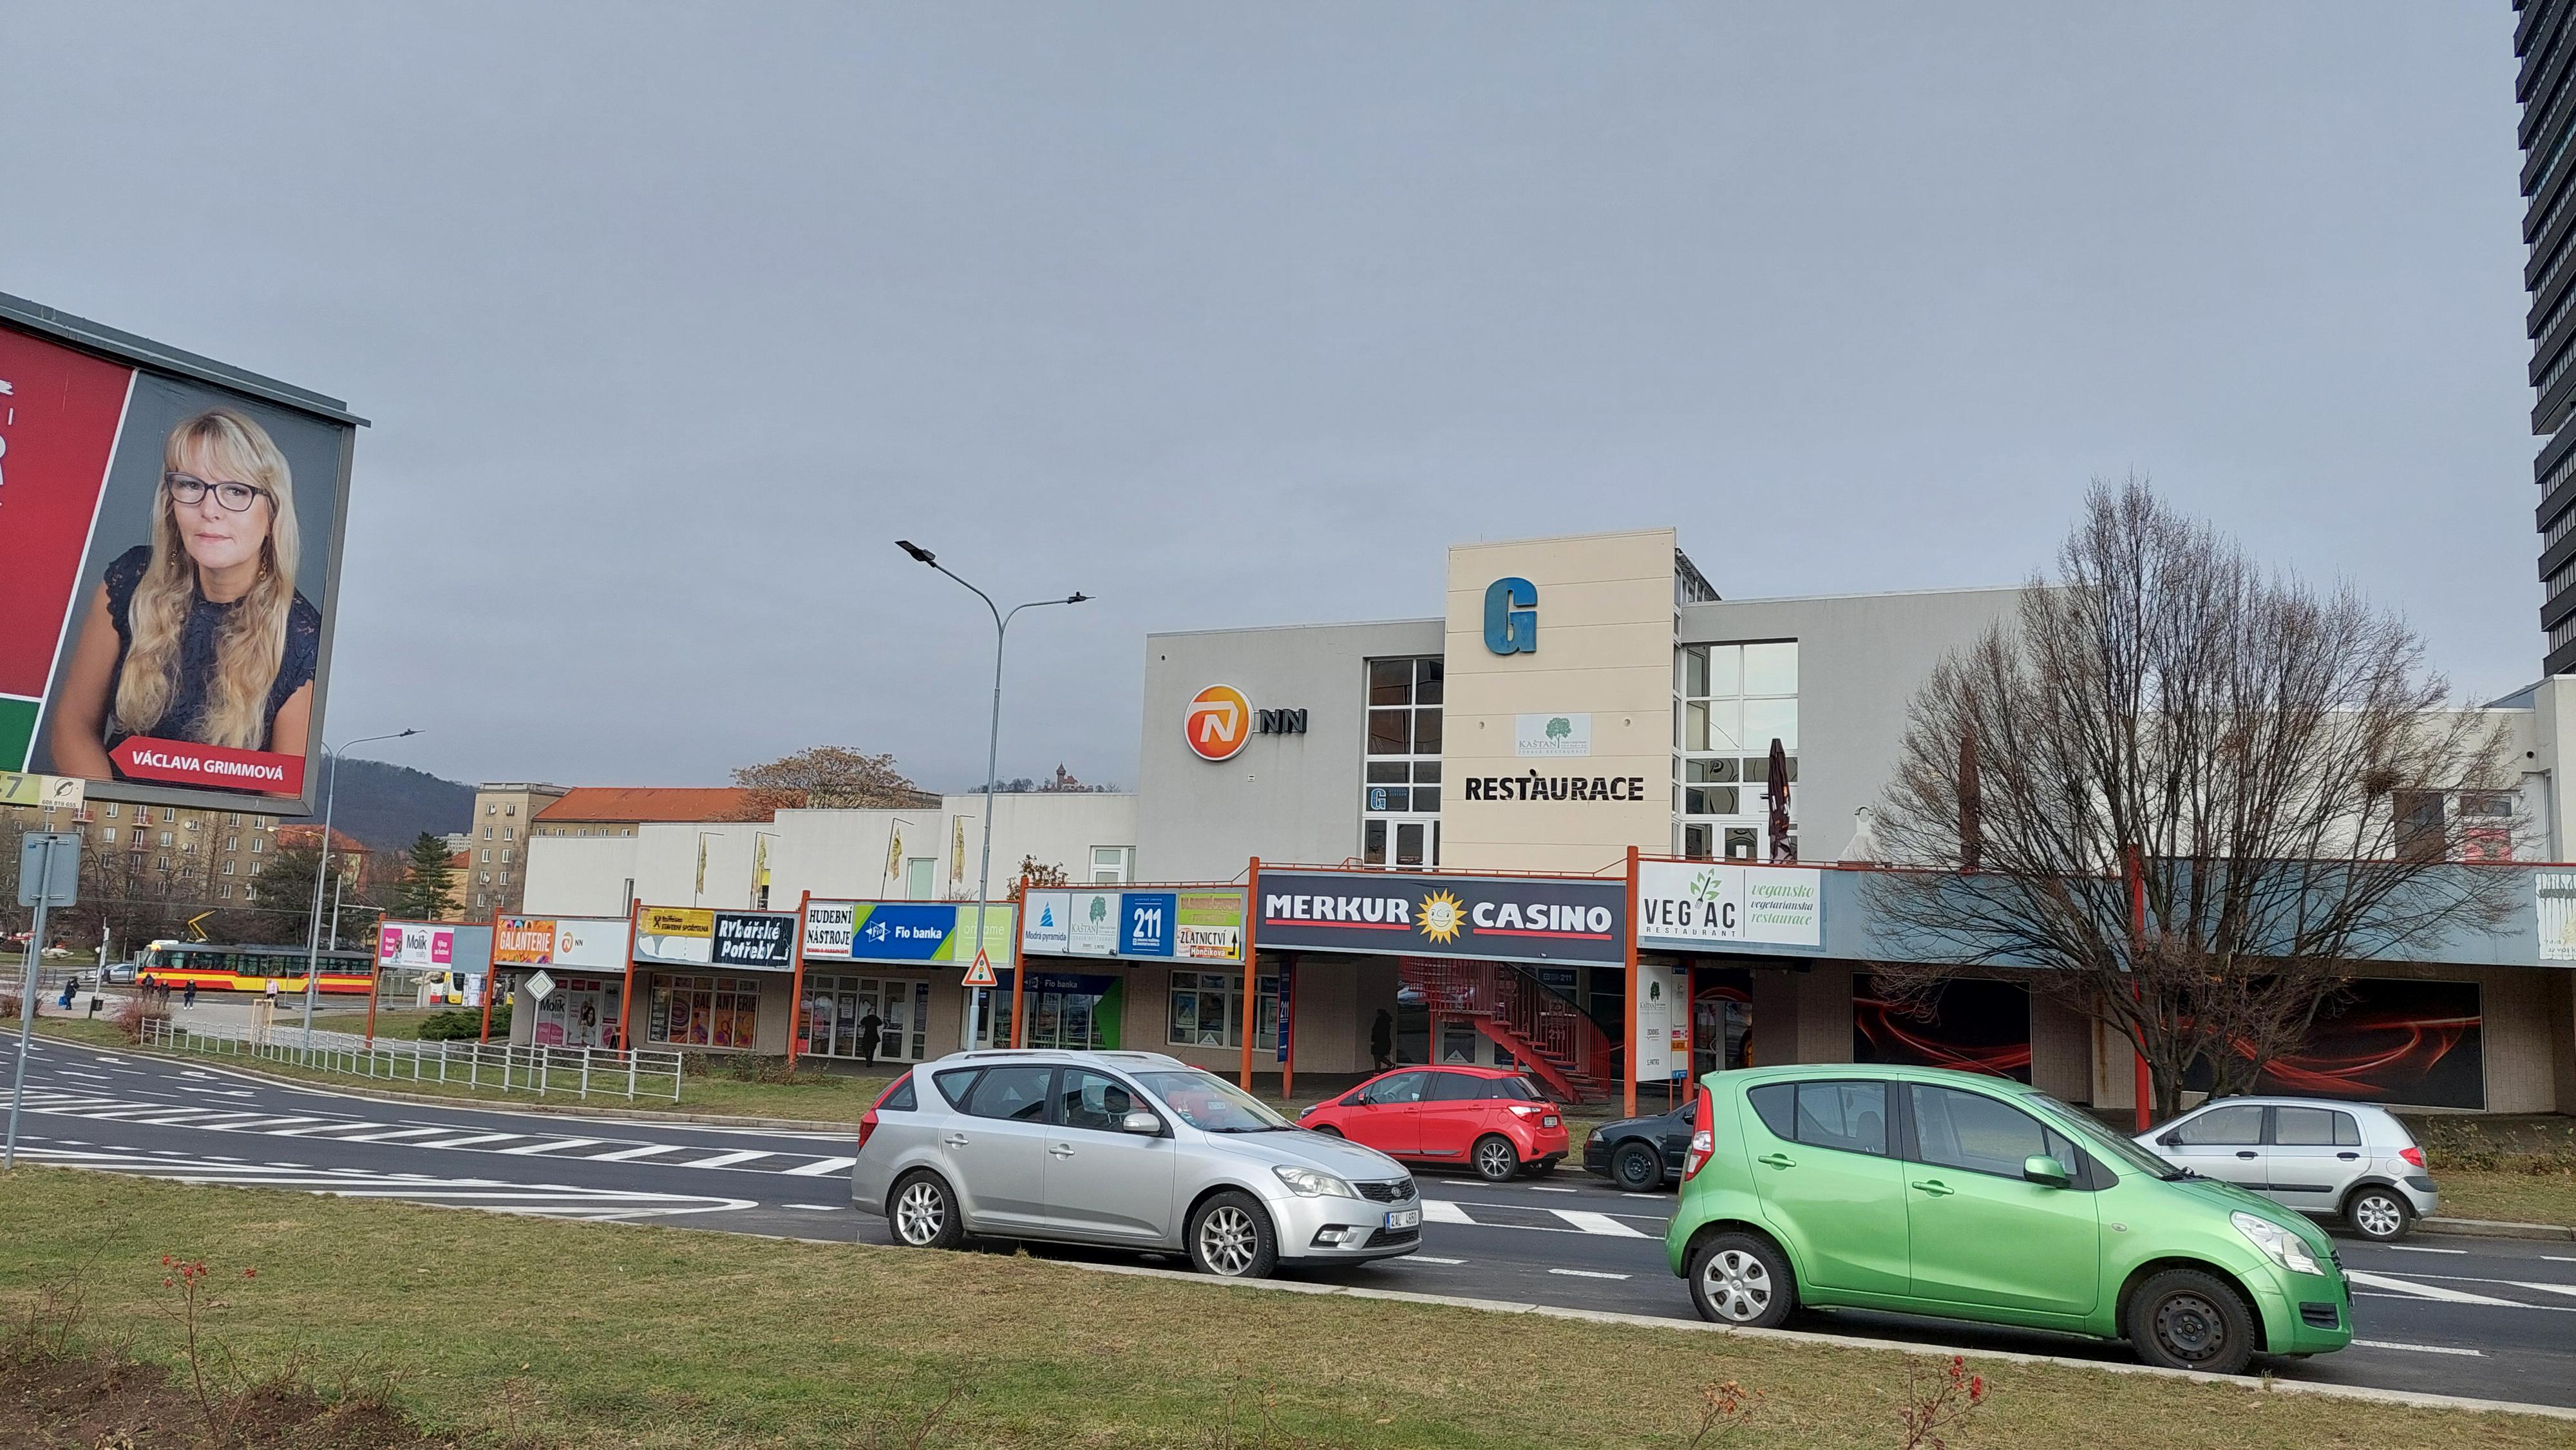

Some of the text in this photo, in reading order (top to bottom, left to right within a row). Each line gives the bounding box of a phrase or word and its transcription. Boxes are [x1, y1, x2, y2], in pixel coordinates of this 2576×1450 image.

[1484, 577, 1538, 655] G
[1259, 709, 1307, 734] NN
[132, 750, 283, 780] VÁCLAVA GRIMMOVÁ
[0, 775, 23, 798] 7
[1465, 777, 1644, 801] RESTAURACE
[1371, 788, 1387, 811] G
[1751, 885, 1815, 899] vegansko
[809, 906, 853, 924] HUDEBNÍ
[1133, 908, 1161, 937] 211
[1265, 894, 1411, 923] MERKUR
[1472, 903, 1613, 933] CASINO
[1644, 899, 1691, 926] VEG
[500, 931, 551, 952] GALANTERIE
[807, 925, 850, 945] NÁSTROJE
[895, 926, 942, 939] Fio banka
[1043, 932, 1066, 942] pyramida
[1180, 929, 1227, 946] ZLATNICTVÍ
[1646, 926, 1736, 937] RESTAURANT
[1045, 979, 1078, 988] Fio banka
[1280, 1001, 1289, 1018] 211
